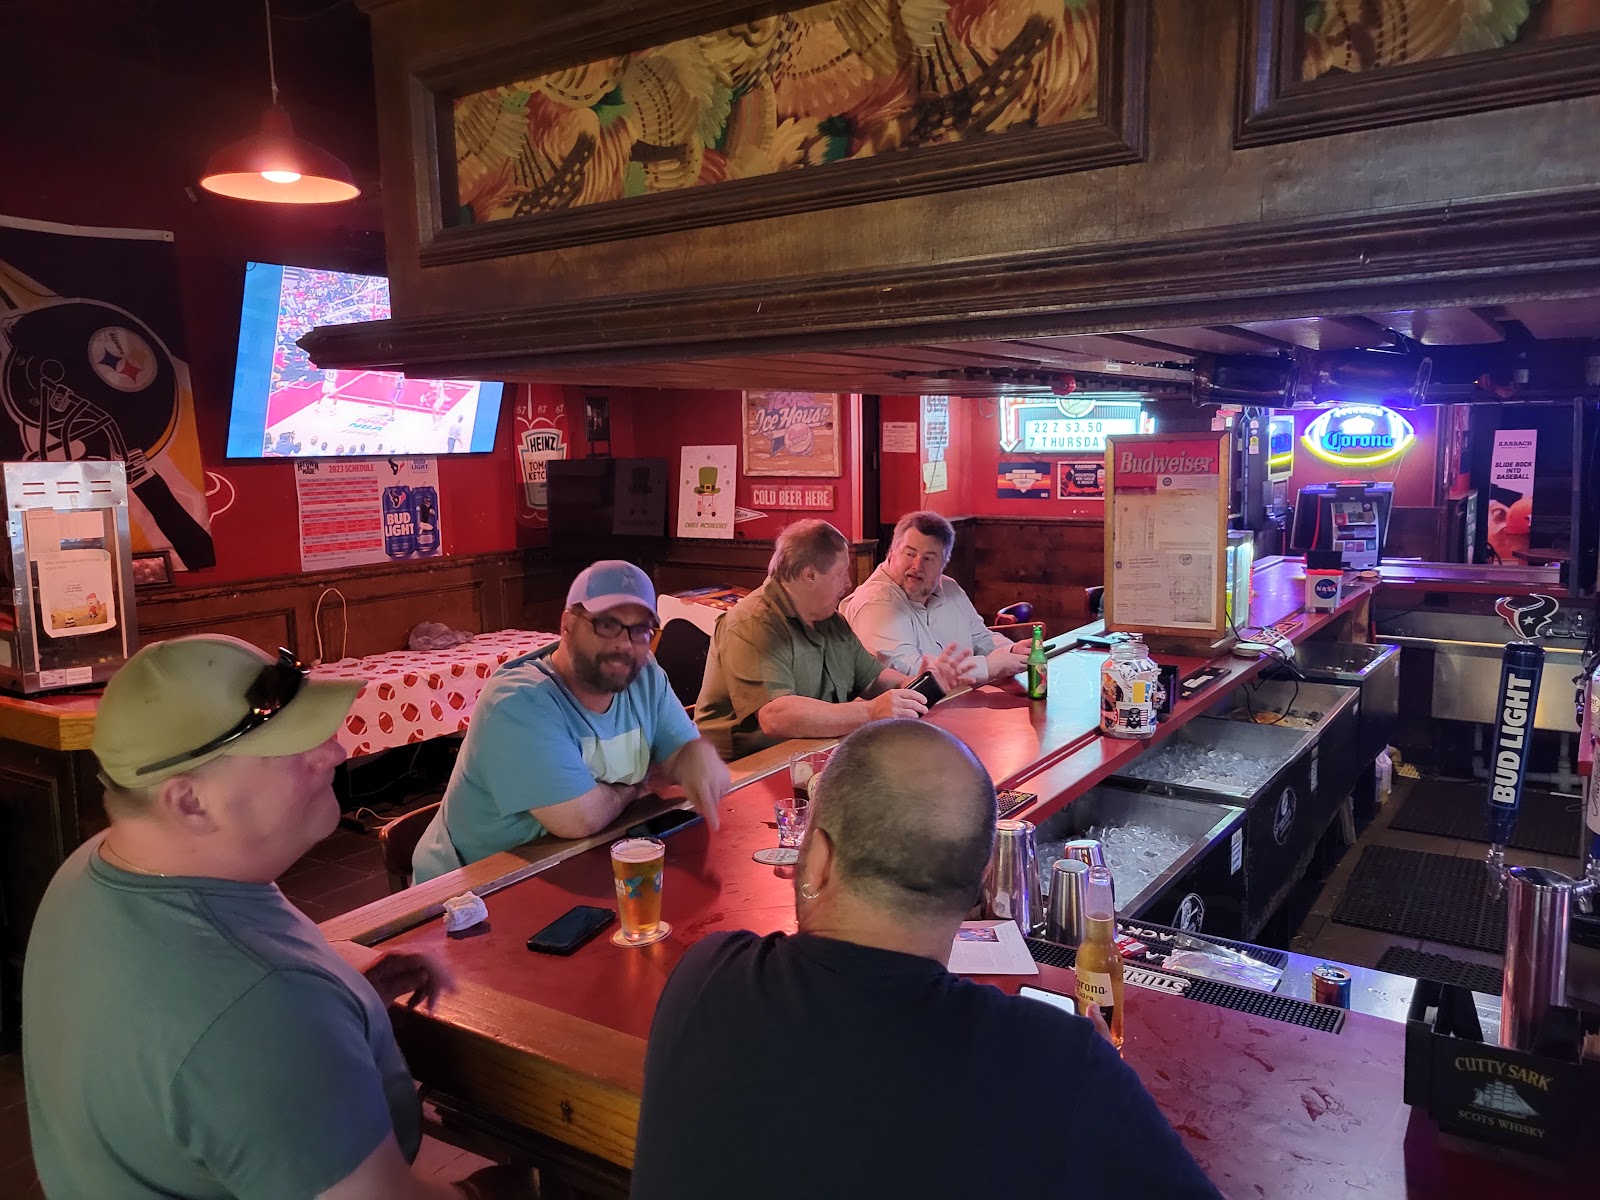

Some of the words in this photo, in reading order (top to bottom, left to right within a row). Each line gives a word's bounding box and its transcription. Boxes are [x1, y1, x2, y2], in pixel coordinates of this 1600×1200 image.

[750, 409, 779, 436] Ice
[777, 405, 831, 429] House
[1034, 422, 1049, 434] 22
[1065, 422, 1103, 434] $3.50
[529, 436, 556, 453] HEINZ
[1322, 430, 1393, 453] Corona
[328, 465, 344, 474] 2023
[345, 464, 375, 473] SCHEDULE
[1119, 450, 1215, 474] Budweiser
[753, 489, 777, 506] COLD
[779, 490, 803, 506] BEER
[805, 490, 830, 507] HERE
[386, 512, 411, 525] BUD
[384, 523, 415, 537] LIGHT
[1315, 583, 1337, 593] NASA
[1500, 673, 1532, 749] LIGHT
[1492, 750, 1521, 804] BUD
[1454, 1056, 1507, 1076] CUTTY
[1507, 1064, 1549, 1092] SARK
[1457, 1108, 1496, 1126] SCOTS
[1497, 1118, 1546, 1139] WHISKY
